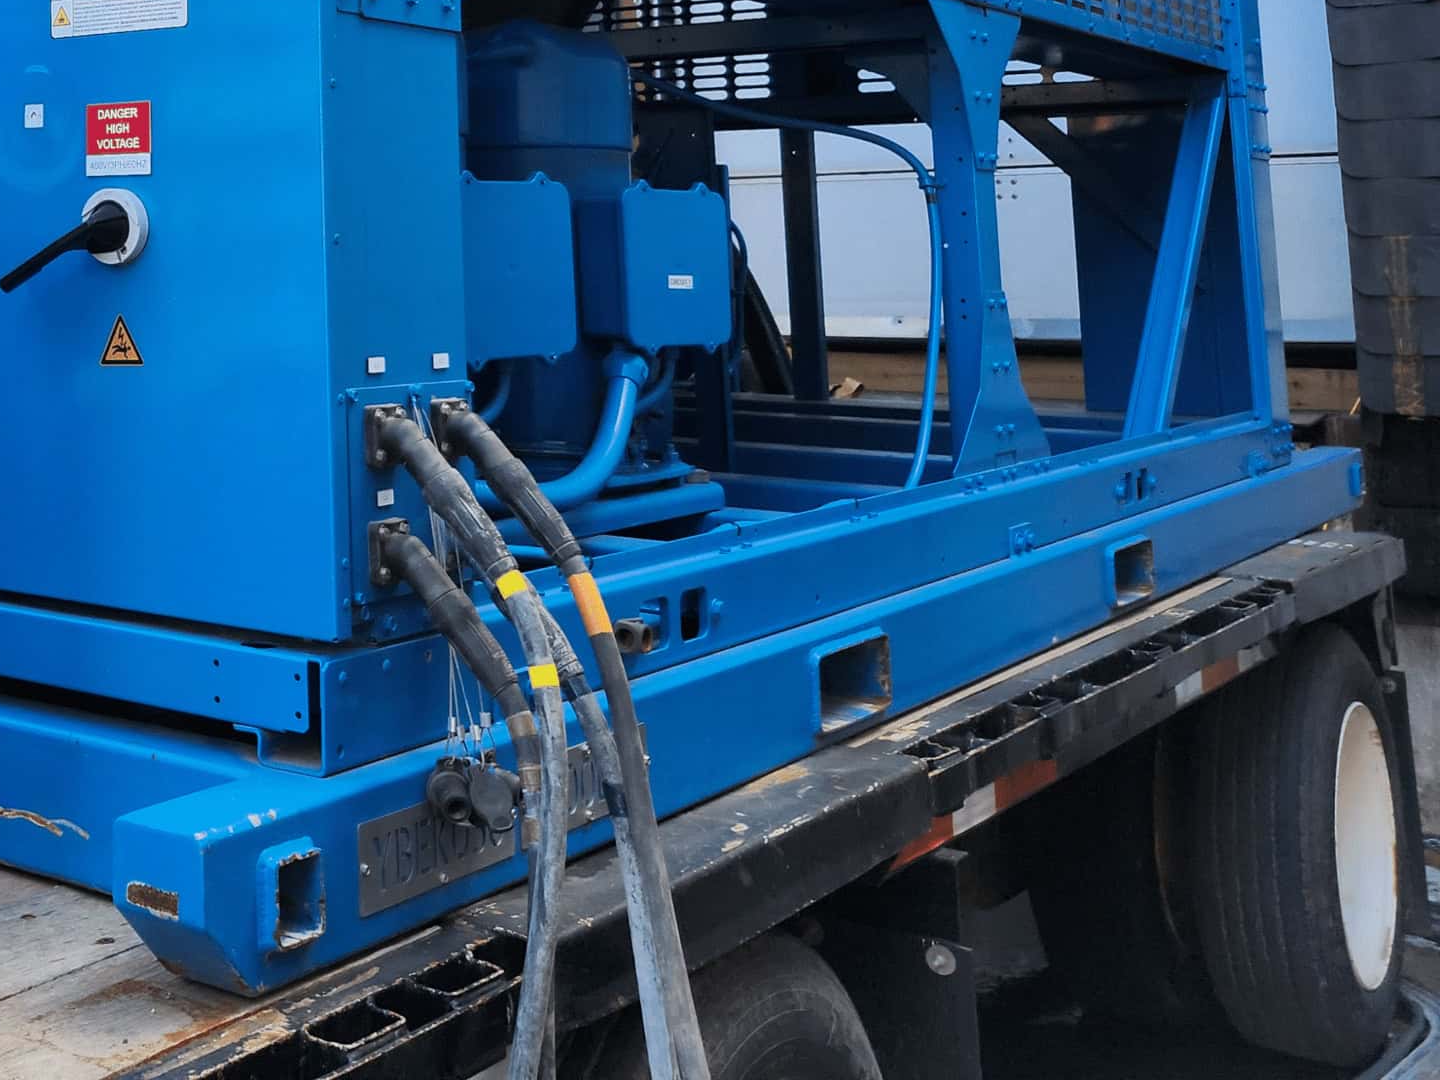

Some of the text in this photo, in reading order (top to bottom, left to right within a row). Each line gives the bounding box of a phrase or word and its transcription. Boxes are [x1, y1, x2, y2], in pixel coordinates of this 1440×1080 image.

[97, 108, 138, 120] DANGER
[105, 122, 130, 135] HIGH
[96, 137, 140, 149] VOLTAGE
